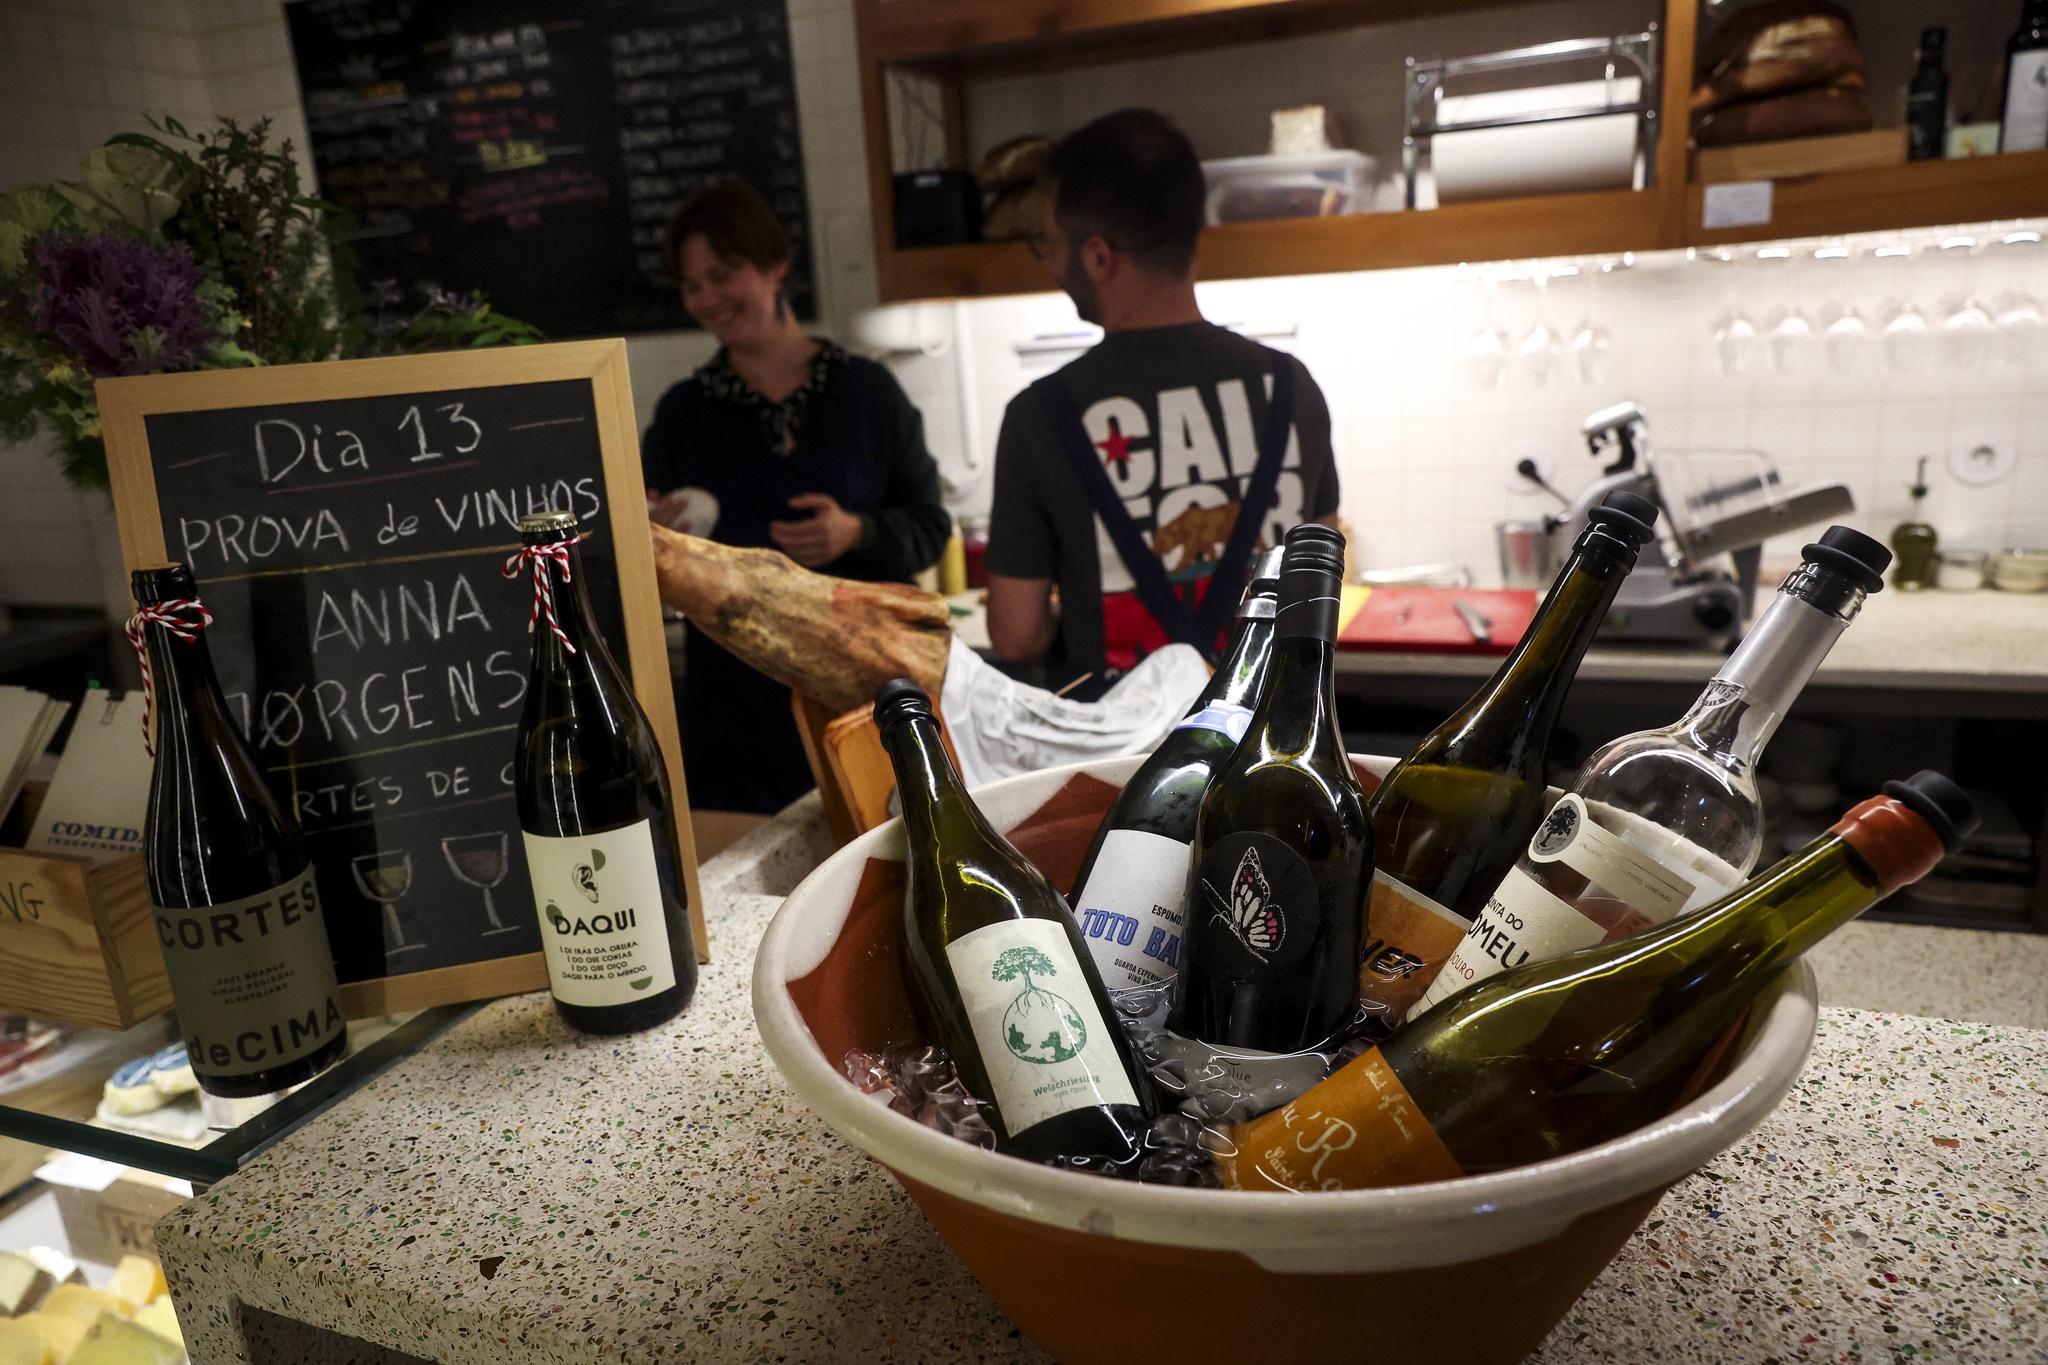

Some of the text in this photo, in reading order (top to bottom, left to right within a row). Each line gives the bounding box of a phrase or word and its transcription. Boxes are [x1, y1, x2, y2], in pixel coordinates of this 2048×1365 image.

[254, 402, 482, 482] Dia 13
[180, 478, 601, 570] PROVA de VINHOS
[312, 573, 492, 654] ANNA
[426, 766, 470, 797] DE
[51, 820, 143, 844] COMID
[157, 880, 316, 950] CORTES
[554, 908, 637, 936] DAQUI
[1081, 908, 1139, 947] TOTO
[1151, 904, 1184, 926] ESPUMO
[1486, 894, 1524, 932] UINTA DO
[1467, 913, 1531, 969] OMEU
[211, 970, 295, 997] VINHO REGIONAL
[244, 962, 286, 980] BRANCO
[584, 971, 605, 980] PARA
